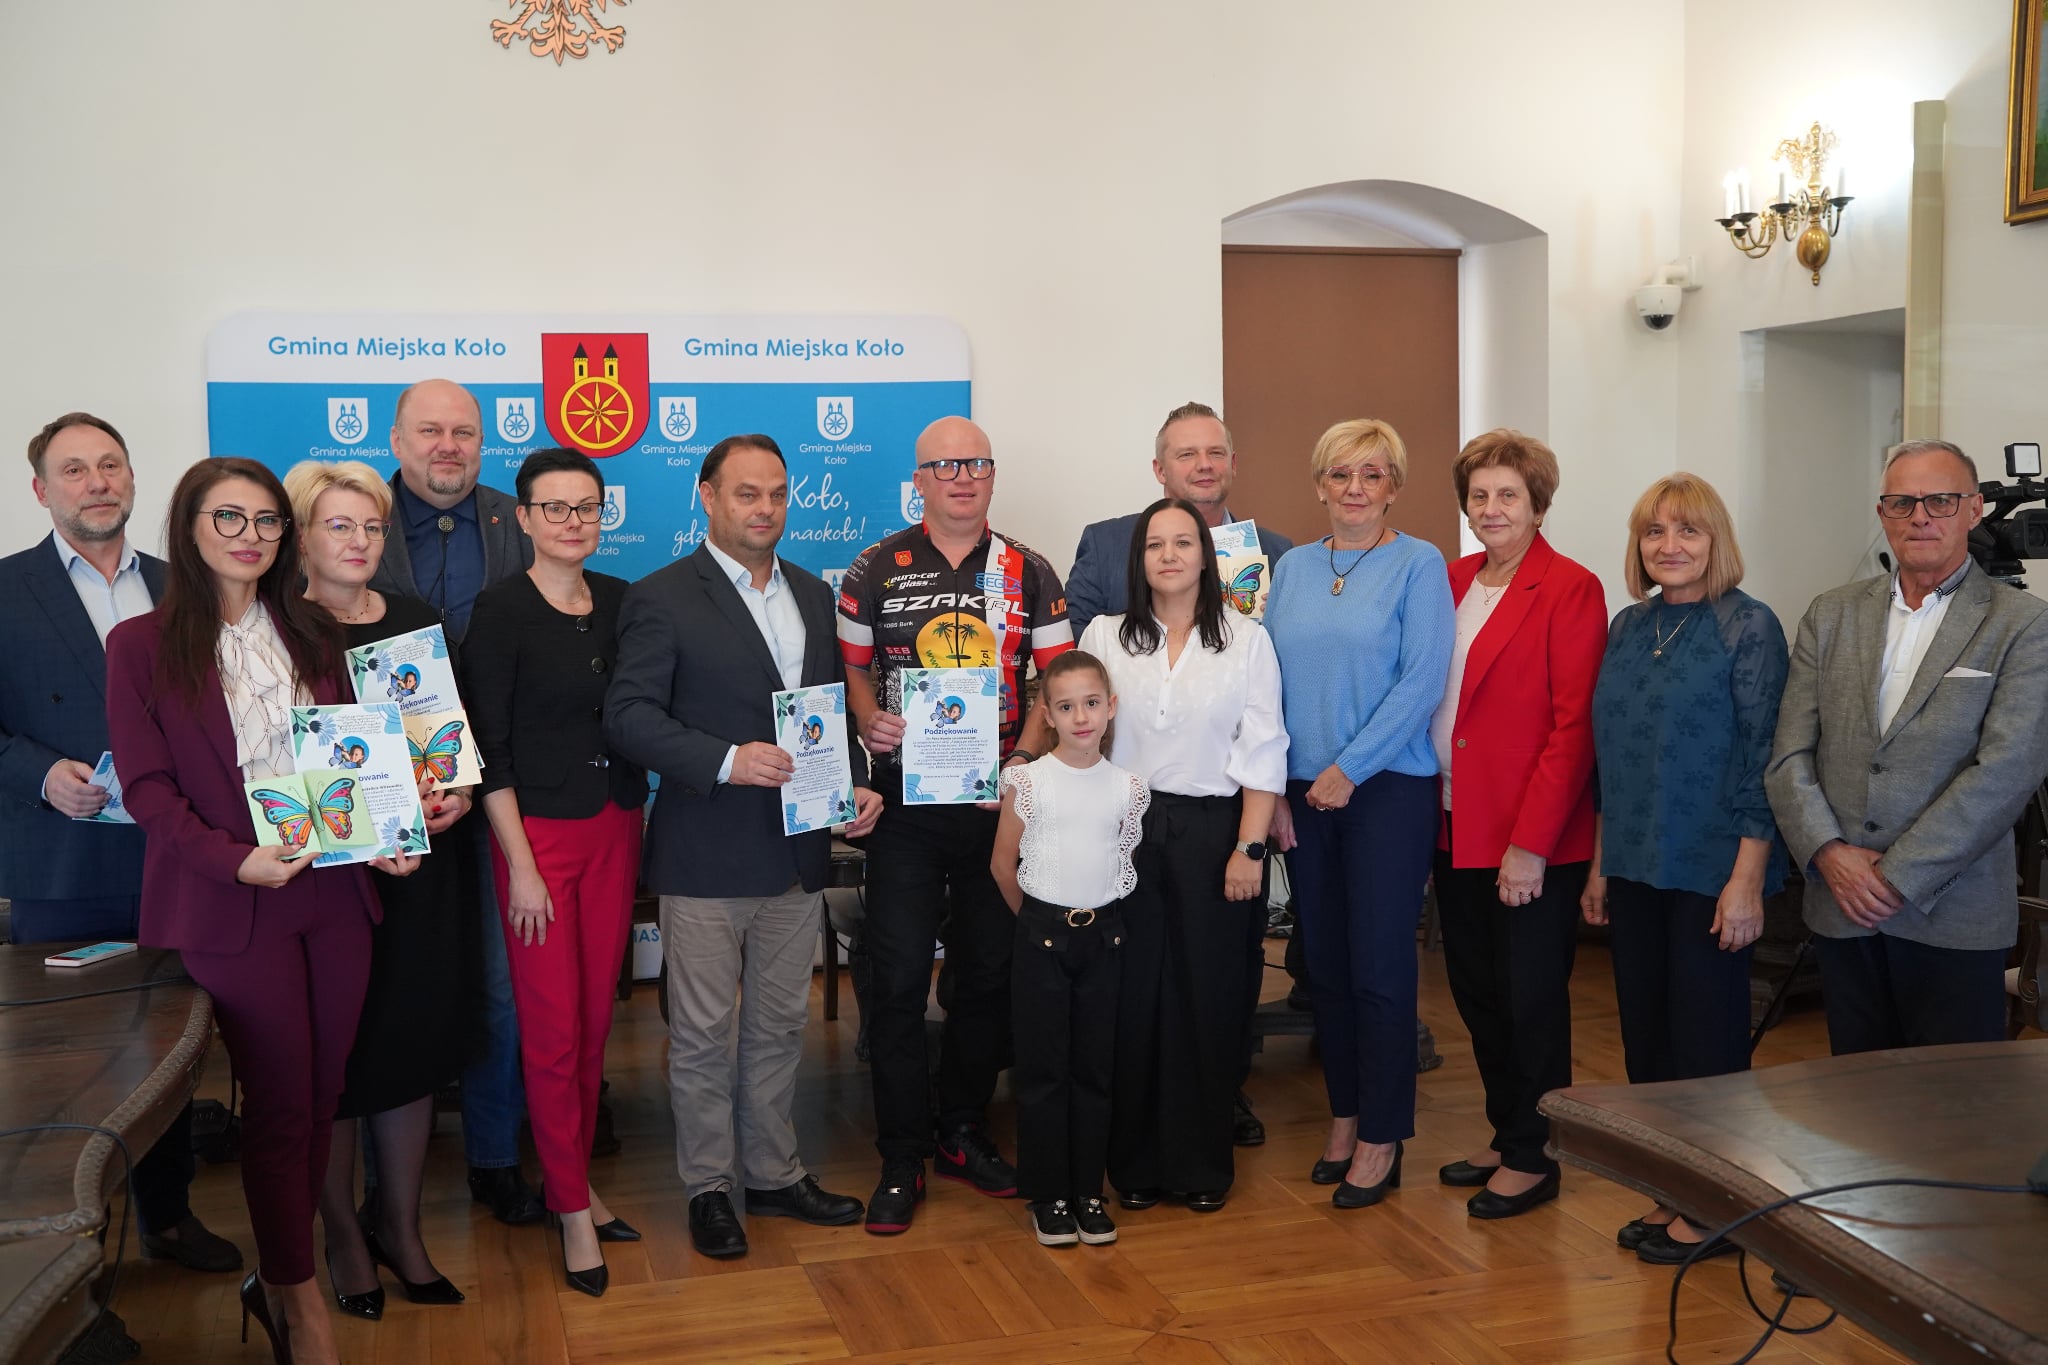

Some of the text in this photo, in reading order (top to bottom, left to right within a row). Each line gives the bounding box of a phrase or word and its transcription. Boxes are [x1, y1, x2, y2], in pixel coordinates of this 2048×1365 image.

[268, 336, 506, 361] Gmina Miejska Koło
[684, 338, 904, 361] Gmina Miejska Koło
[309, 446, 389, 458] Gmina Miejska
[480, 445, 514, 456] Gmina
[641, 444, 676, 454] Gmina
[799, 442, 872, 455] Gmina Miejska
[505, 459, 523, 468] Koł
[667, 457, 691, 466] Koło
[824, 455, 847, 465] Koło
[607, 533, 645, 544] Miejska
[671, 516, 866, 556] gdzi naokoło!
[596, 546, 620, 555] Koło
[890, 572, 941, 583] euro-car
[898, 580, 929, 590] glass
[881, 593, 1029, 617] SZAKAL
[924, 727, 978, 735] Podziękowanie
